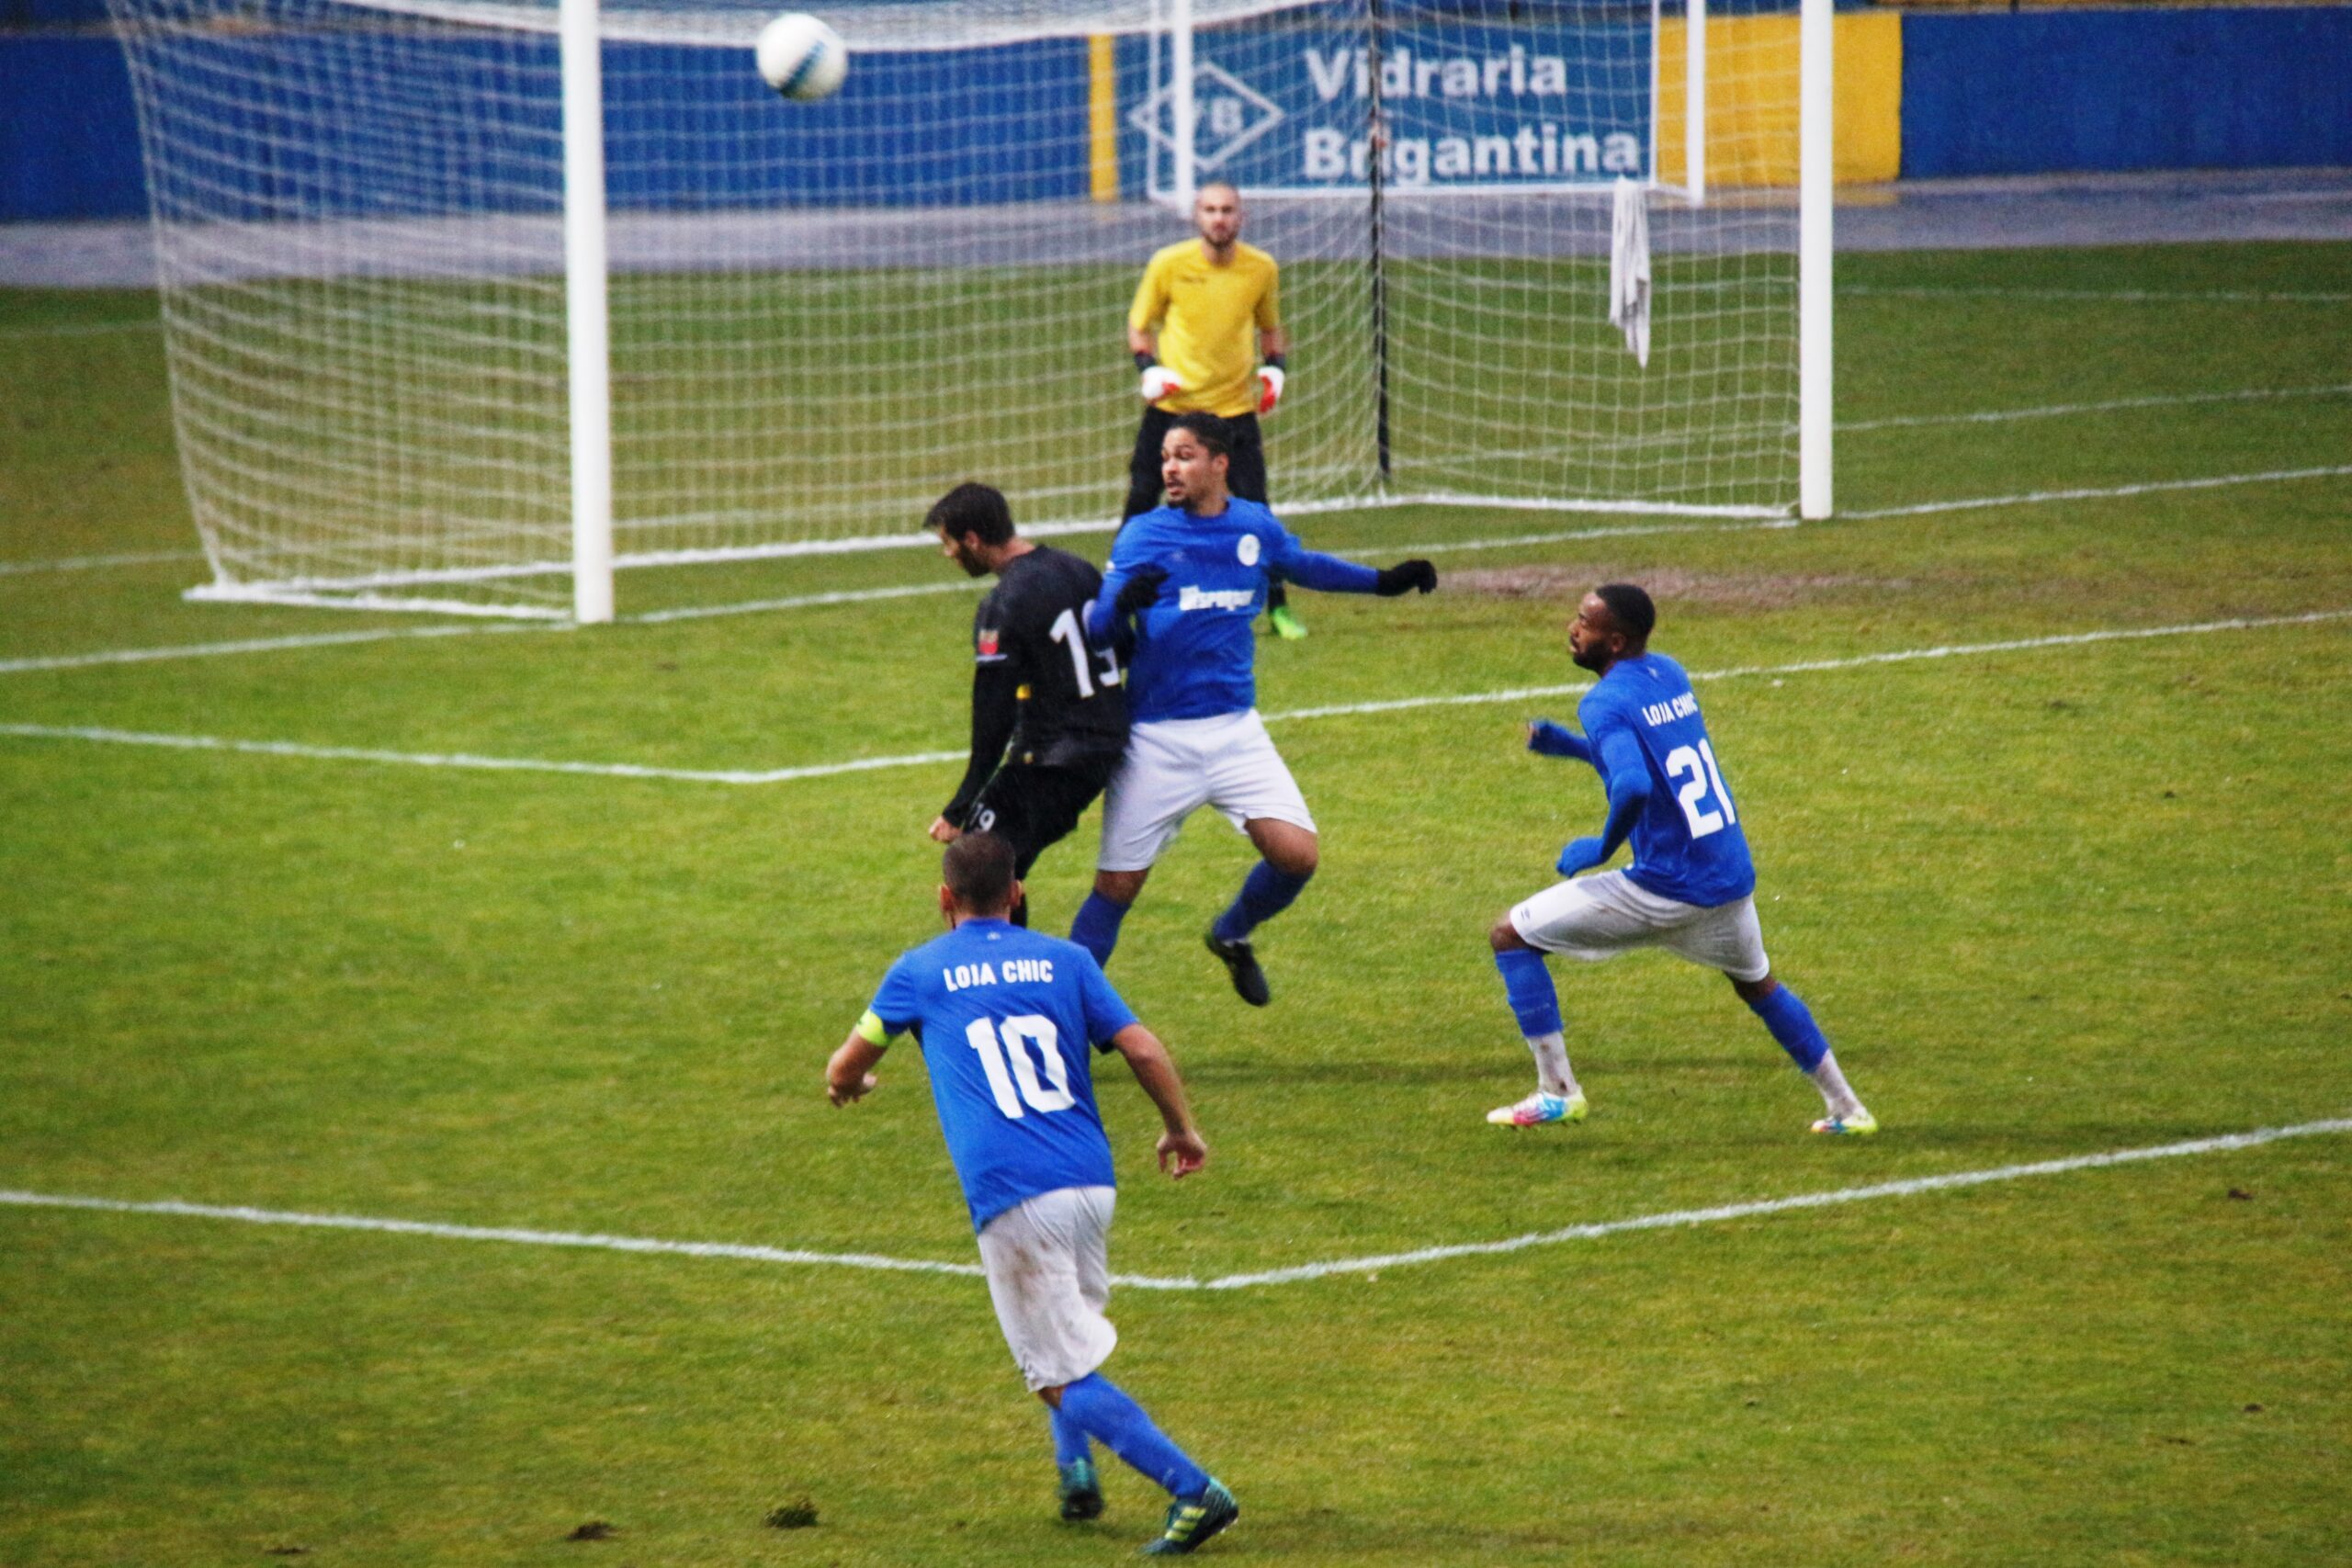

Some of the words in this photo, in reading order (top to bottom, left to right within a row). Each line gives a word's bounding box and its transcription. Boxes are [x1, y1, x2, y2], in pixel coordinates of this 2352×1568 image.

[1305, 44, 1567, 100] Vidraria
[1304, 123, 1640, 185] Brigantina
[1665, 738, 1736, 840] 21
[1001, 959, 1053, 984] CHIC
[965, 1013, 1077, 1119] 10
